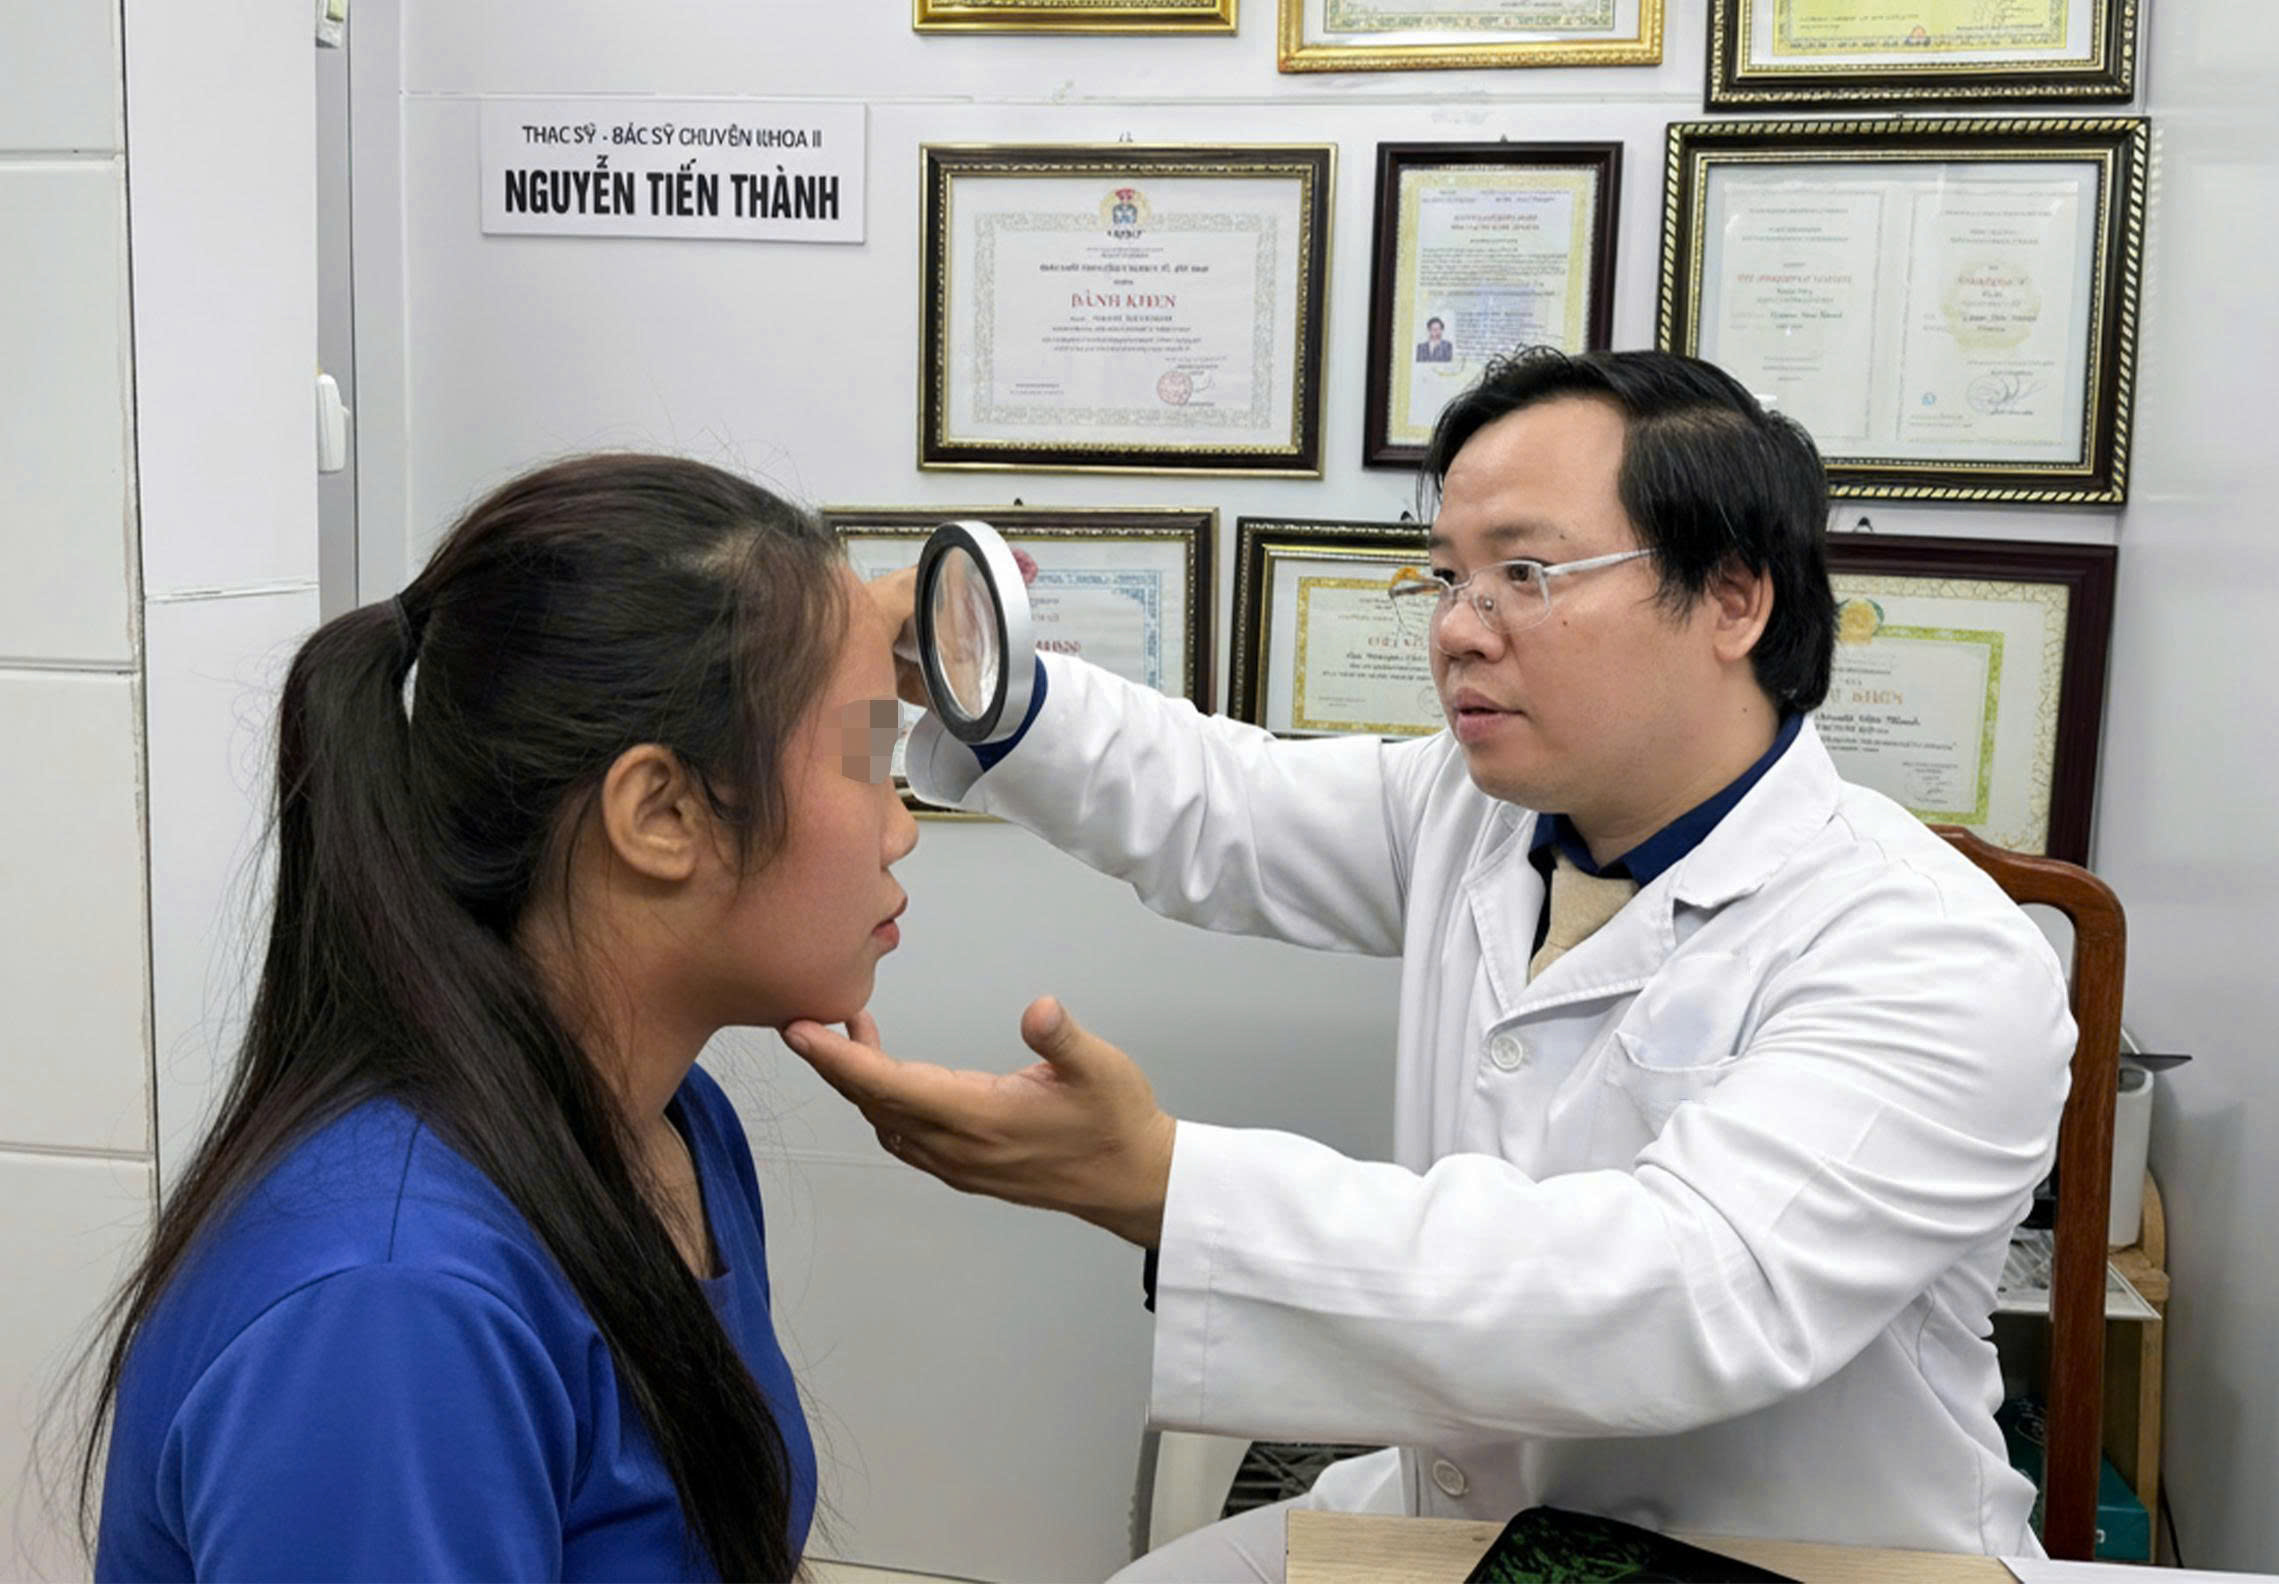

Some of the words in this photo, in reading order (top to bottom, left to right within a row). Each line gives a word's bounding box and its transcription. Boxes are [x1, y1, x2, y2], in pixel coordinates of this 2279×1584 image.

[505, 154, 635, 215] NGUYỄN
[646, 158, 719, 217] TIẾN
[730, 164, 839, 220] THÀNH
